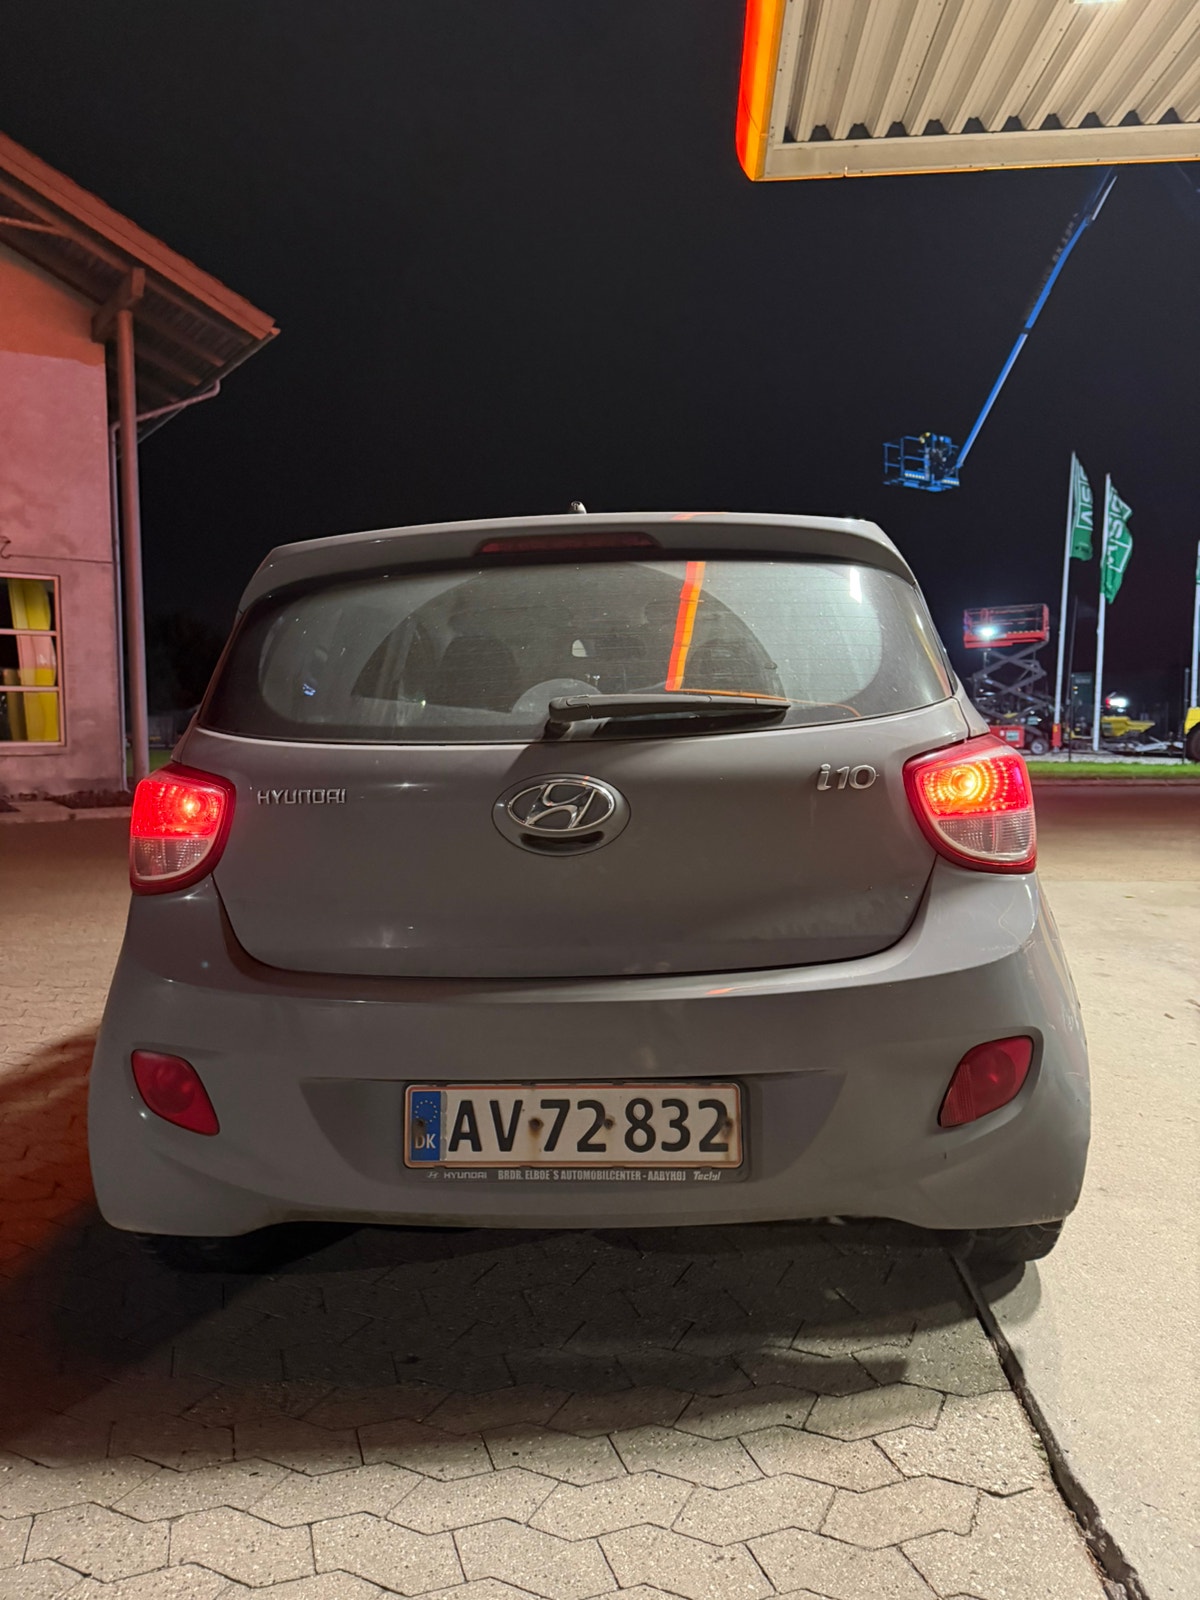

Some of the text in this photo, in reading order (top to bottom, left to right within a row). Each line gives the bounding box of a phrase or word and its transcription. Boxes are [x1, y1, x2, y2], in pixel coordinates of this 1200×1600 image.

[816, 763, 877, 791] i10
[257, 788, 346, 805] HYUNDAI
[447, 1098, 730, 1153] AV 72 832
[414, 1133, 437, 1149] DK
[443, 1171, 488, 1179] HYUNDAI
[498, 1170, 523, 1180] BRDR.
[560, 1170, 641, 1180] AUTOMOBILCENTER
